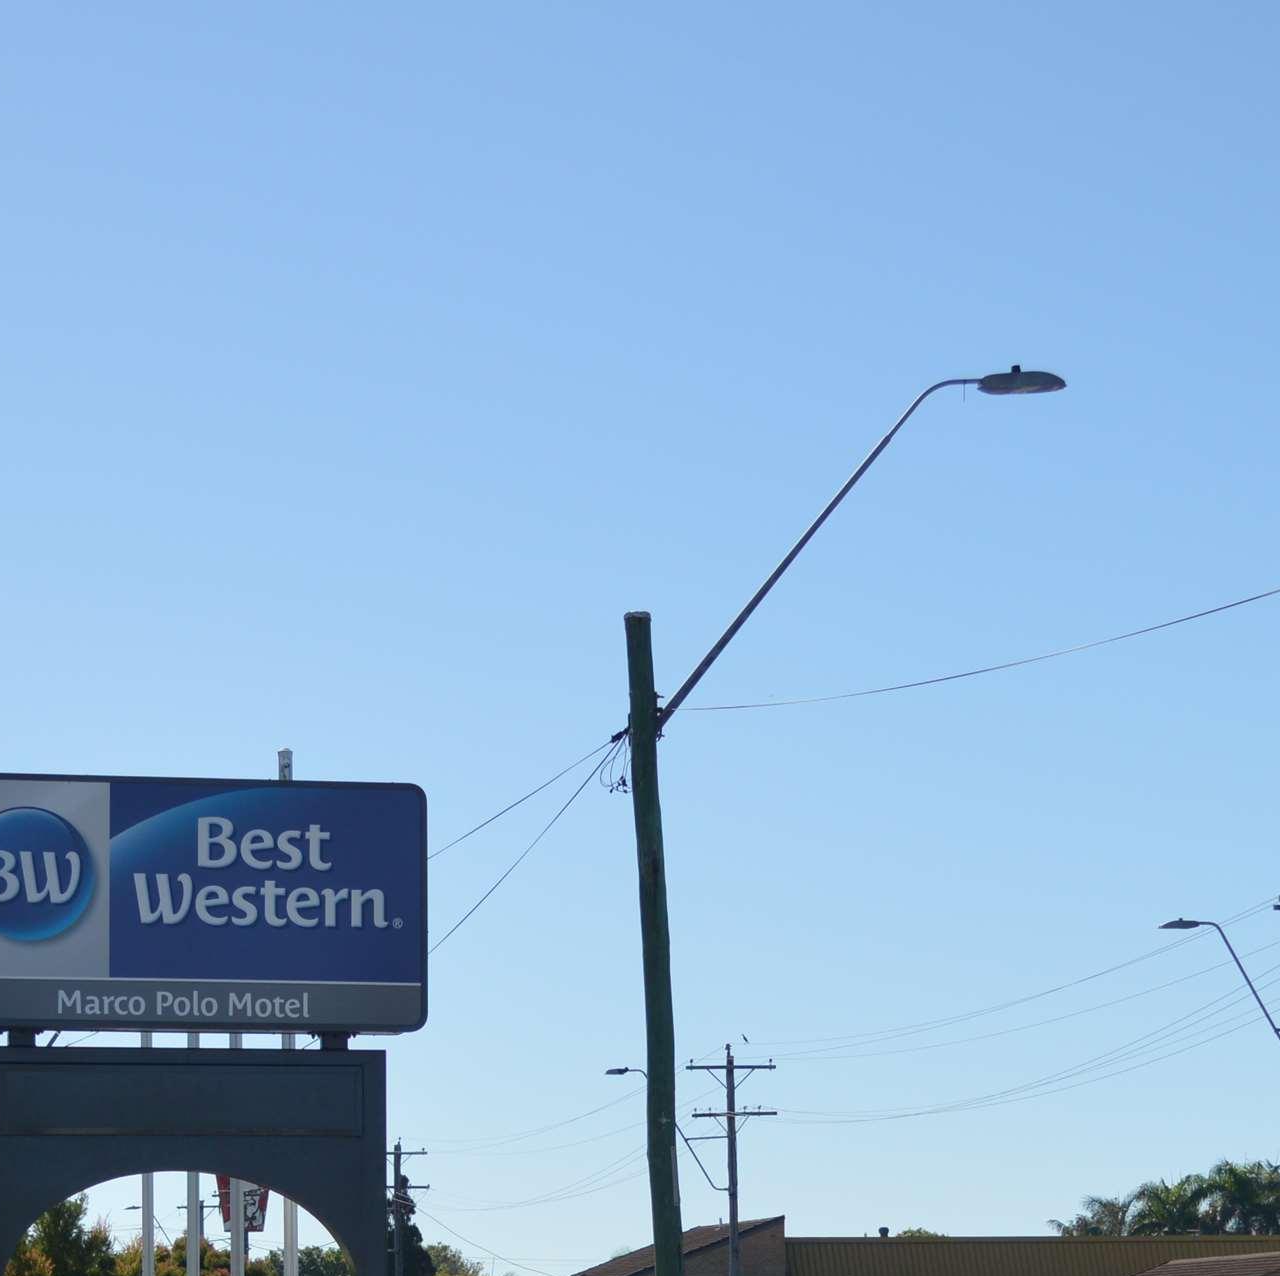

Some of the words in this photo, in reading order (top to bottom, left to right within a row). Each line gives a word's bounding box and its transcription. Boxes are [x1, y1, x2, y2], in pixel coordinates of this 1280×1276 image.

[197, 816, 332, 871] Best
[57, 990, 146, 1016] Marco
[156, 991, 218, 1017] Polo
[228, 992, 310, 1018] Motel
